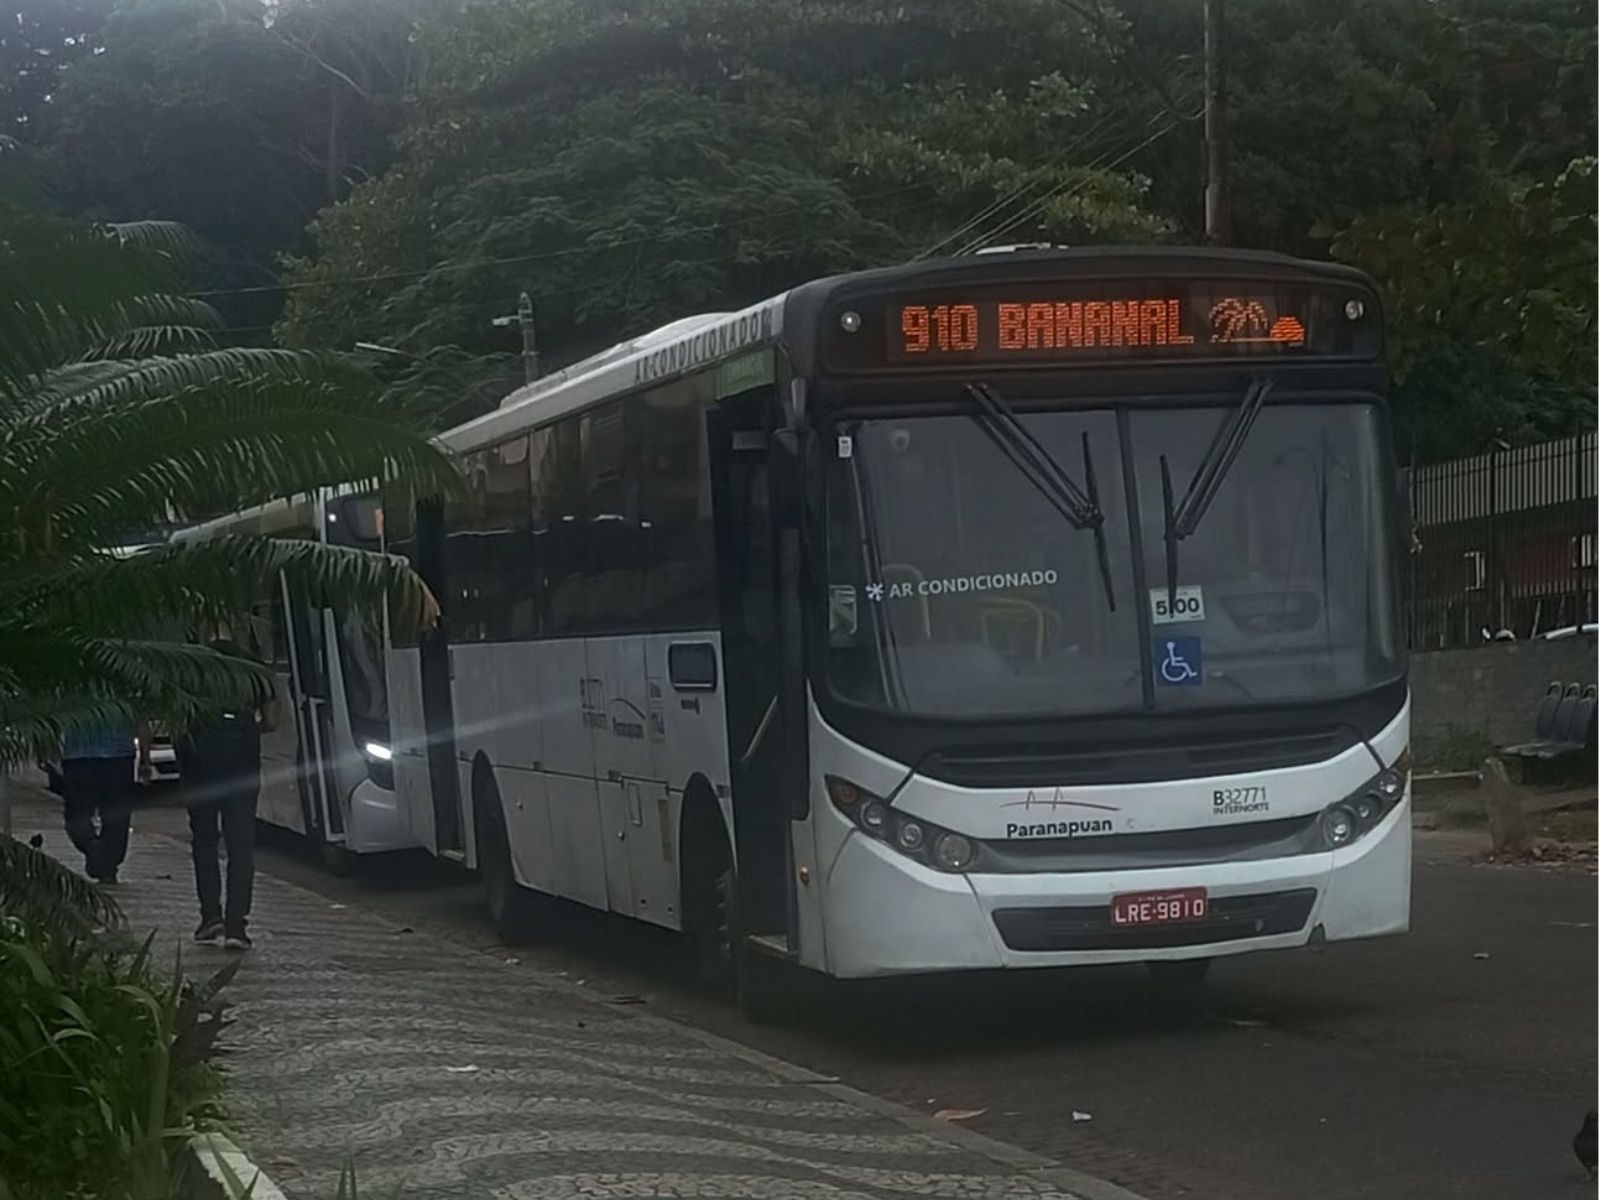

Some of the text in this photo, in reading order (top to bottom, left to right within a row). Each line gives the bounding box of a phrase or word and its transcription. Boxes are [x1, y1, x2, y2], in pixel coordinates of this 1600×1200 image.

[902, 300, 1194, 351] 910 BANANAL
[653, 313, 759, 377] CONDICIONADO
[889, 569, 1058, 598] AR CONDICIONADO
[1212, 787, 1267, 806] B32771
[1006, 818, 1113, 838] Paranapuan
